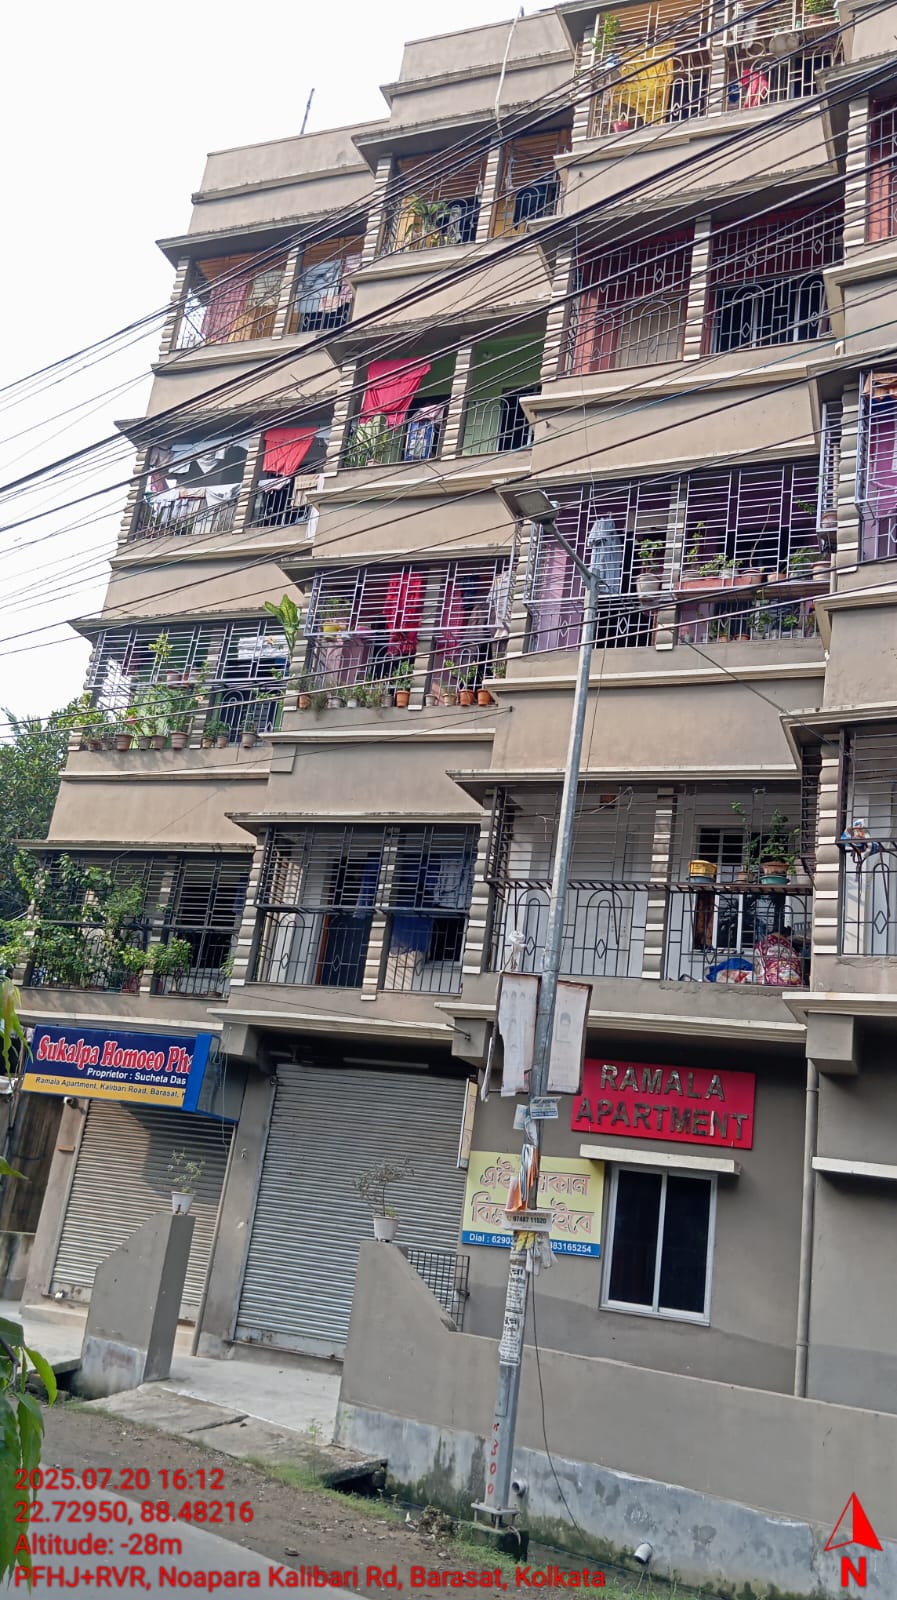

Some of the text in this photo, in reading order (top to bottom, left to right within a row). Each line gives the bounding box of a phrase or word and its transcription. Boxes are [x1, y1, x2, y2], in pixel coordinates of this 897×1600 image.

[37, 1035, 100, 1070] Sukalpa
[101, 1041, 165, 1071] Homoeo
[35, 1076, 60, 1085] Ramala
[87, 1067, 128, 1079] Proprietor
[134, 1072, 168, 1083] Sucheta
[169, 1075, 187, 1085] Das
[600, 1064, 726, 1102] RAMALA
[575, 1097, 749, 1140] APARTMENT
[469, 1232, 485, 1242] Dial
